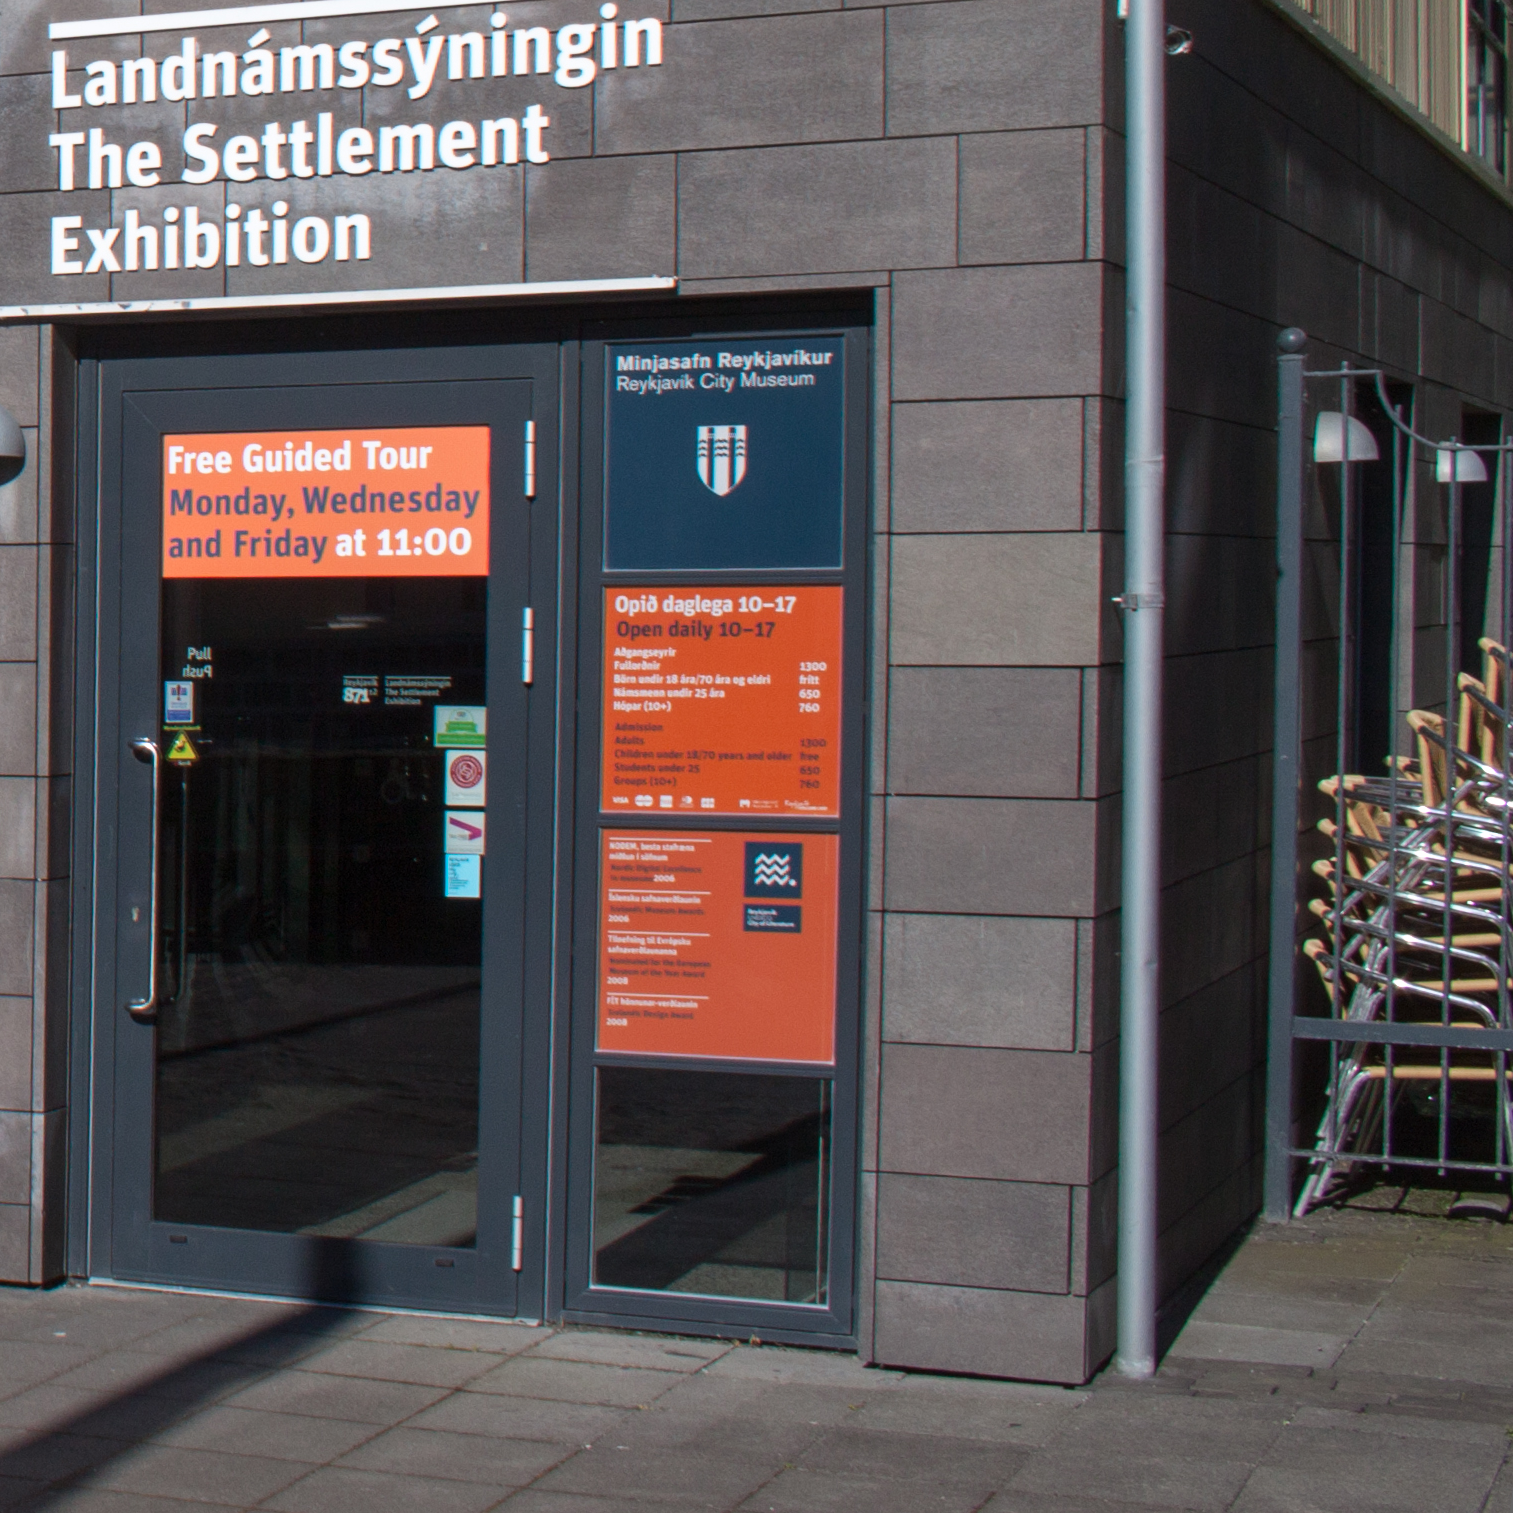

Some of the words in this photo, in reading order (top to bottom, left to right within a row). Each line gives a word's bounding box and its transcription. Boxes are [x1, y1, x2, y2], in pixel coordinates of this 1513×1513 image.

[51, 2, 663, 109] Landnámssýningin
[49, 127, 162, 191] The
[181, 104, 550, 185] Settlement
[51, 200, 371, 275] Exhibition
[617, 354, 711, 373] Minjasafn
[700, 373, 735, 393] City
[740, 371, 815, 388] Museum
[168, 445, 232, 475] Free
[242, 440, 351, 473] Guided
[362, 440, 433, 470] Tour
[169, 486, 295, 522] Monday,
[302, 482, 480, 519] Wednesday
[168, 529, 222, 558] and
[234, 528, 328, 564] Friday
[335, 528, 366, 557] at
[377, 527, 472, 557] 11:00
[615, 595, 657, 616] Opið
[662, 595, 733, 616] daglega
[617, 621, 663, 640] Open
[668, 620, 713, 640] daily
[187, 647, 212, 660] Pull
[799, 662, 827, 672] 1300
[613, 673, 636, 684] Börn
[638, 674, 664, 684] undir
[733, 676, 745, 686] og
[799, 689, 820, 700] 650
[644, 700, 672, 712] (10+)
[799, 703, 820, 713] 760
[615, 722, 663, 732] Admission
[800, 738, 826, 748] 1300
[747, 751, 765, 761] and
[800, 766, 820, 775] 650
